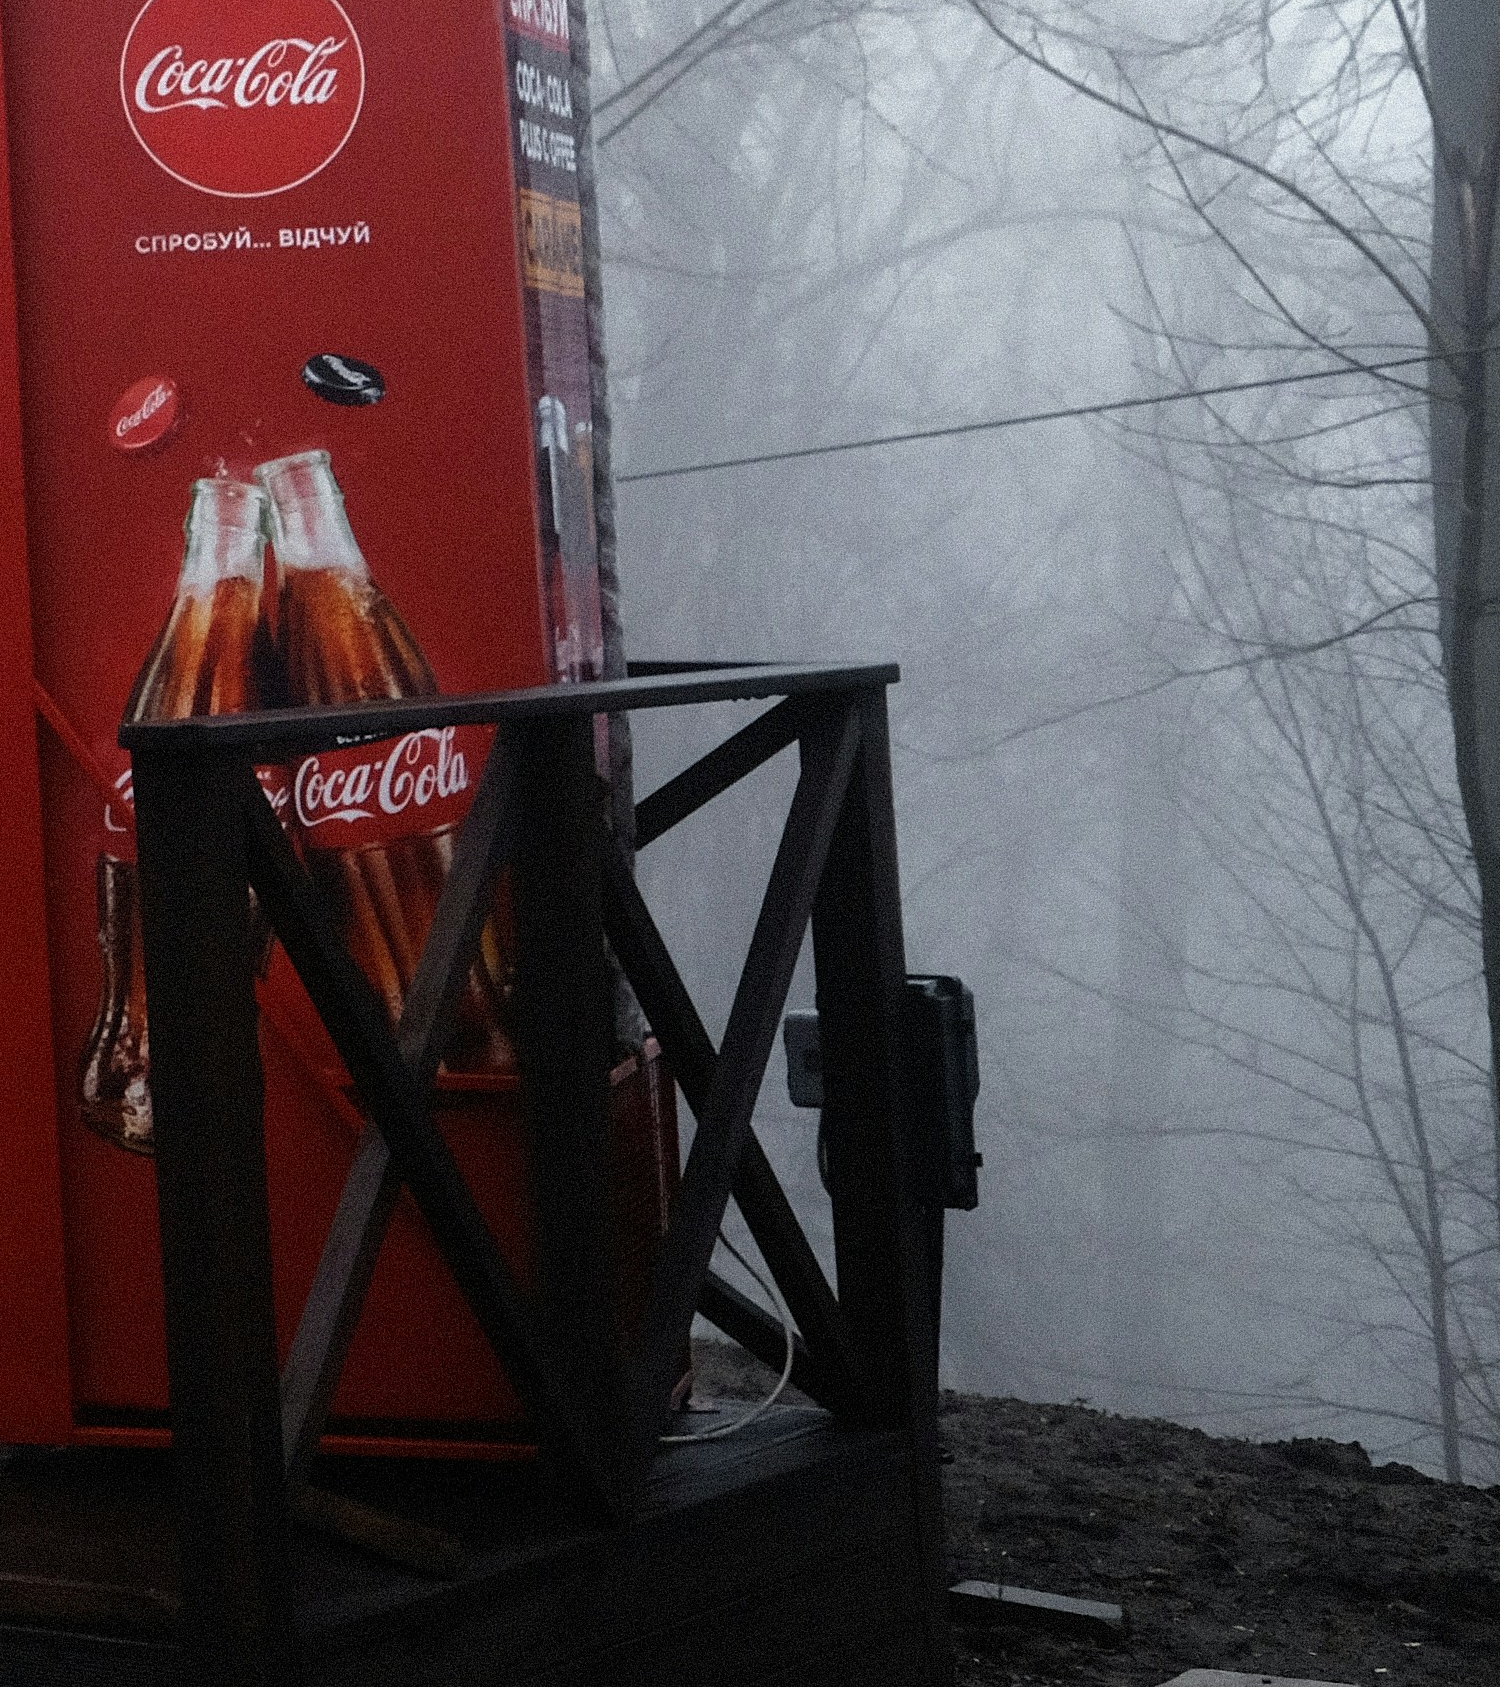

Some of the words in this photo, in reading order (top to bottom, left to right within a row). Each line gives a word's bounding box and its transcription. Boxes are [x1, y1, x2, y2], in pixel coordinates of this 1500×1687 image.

[135, 36, 348, 113] Coca-Cola
[135, 226, 271, 254] СПРОБУЙ...
[278, 221, 371, 249] ВІДЧУЙ
[295, 726, 466, 827] Coca-Cola
